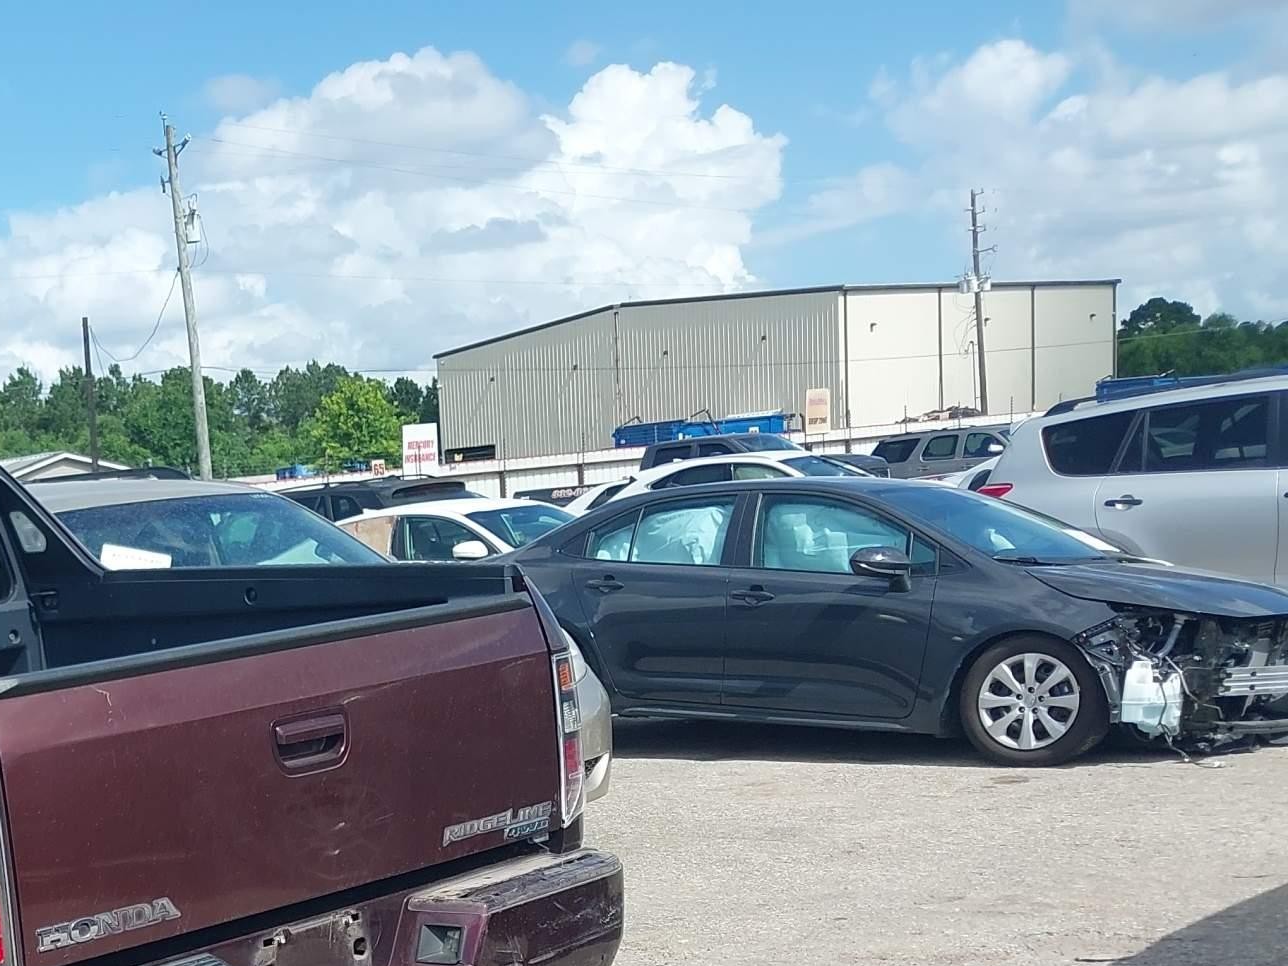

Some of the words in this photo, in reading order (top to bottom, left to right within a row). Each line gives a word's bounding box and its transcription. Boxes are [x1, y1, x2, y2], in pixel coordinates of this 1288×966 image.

[373, 463, 385, 476] 65
[442, 800, 552, 848] RIDGELINE
[505, 818, 550, 840] 4WD
[35, 896, 182, 953] HONDA
